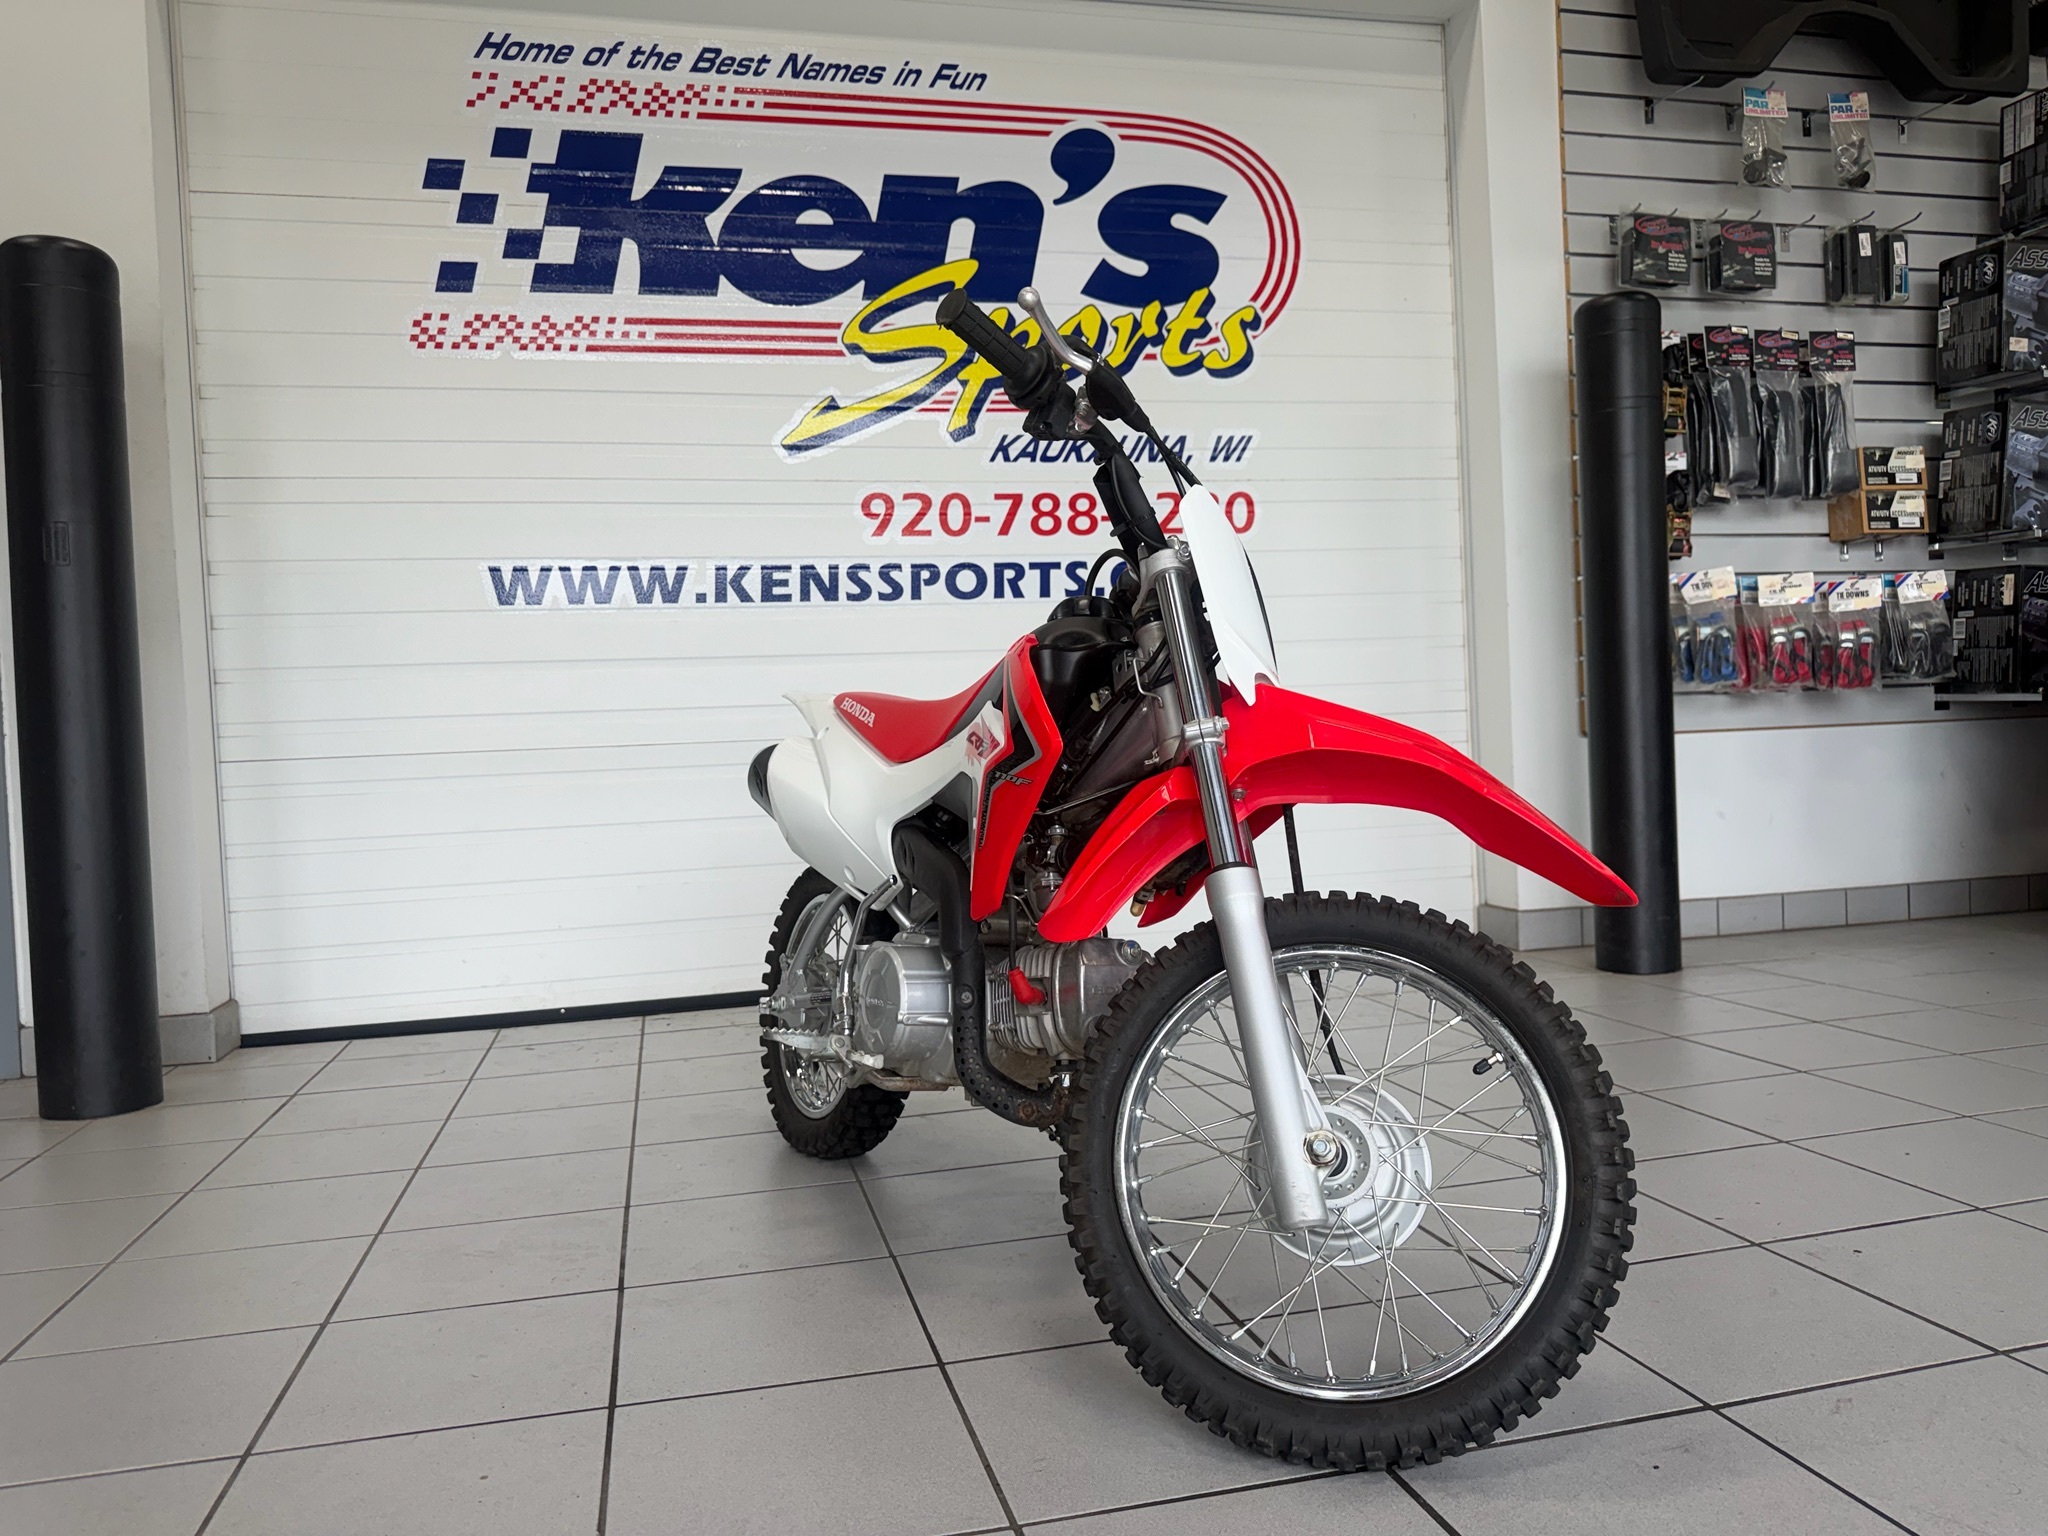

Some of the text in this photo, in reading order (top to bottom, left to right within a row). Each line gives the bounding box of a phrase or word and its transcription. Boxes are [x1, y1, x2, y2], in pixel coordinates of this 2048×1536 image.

[474, 32, 987, 91] Home of the Best Names in Fun
[1745, 98, 1785, 110] PAR
[1745, 107, 1787, 116] UNLIMITED
[1831, 104, 1867, 113] PAR
[1832, 111, 1868, 120] UNLIMITED
[782, 259, 1262, 454] Sports
[989, 434, 1253, 464] KAUKUNA, WI
[861, 492, 1255, 537] 920-788-20
[1845, 590, 1870, 599] DOWNS
[840, 697, 875, 728] HONDA
